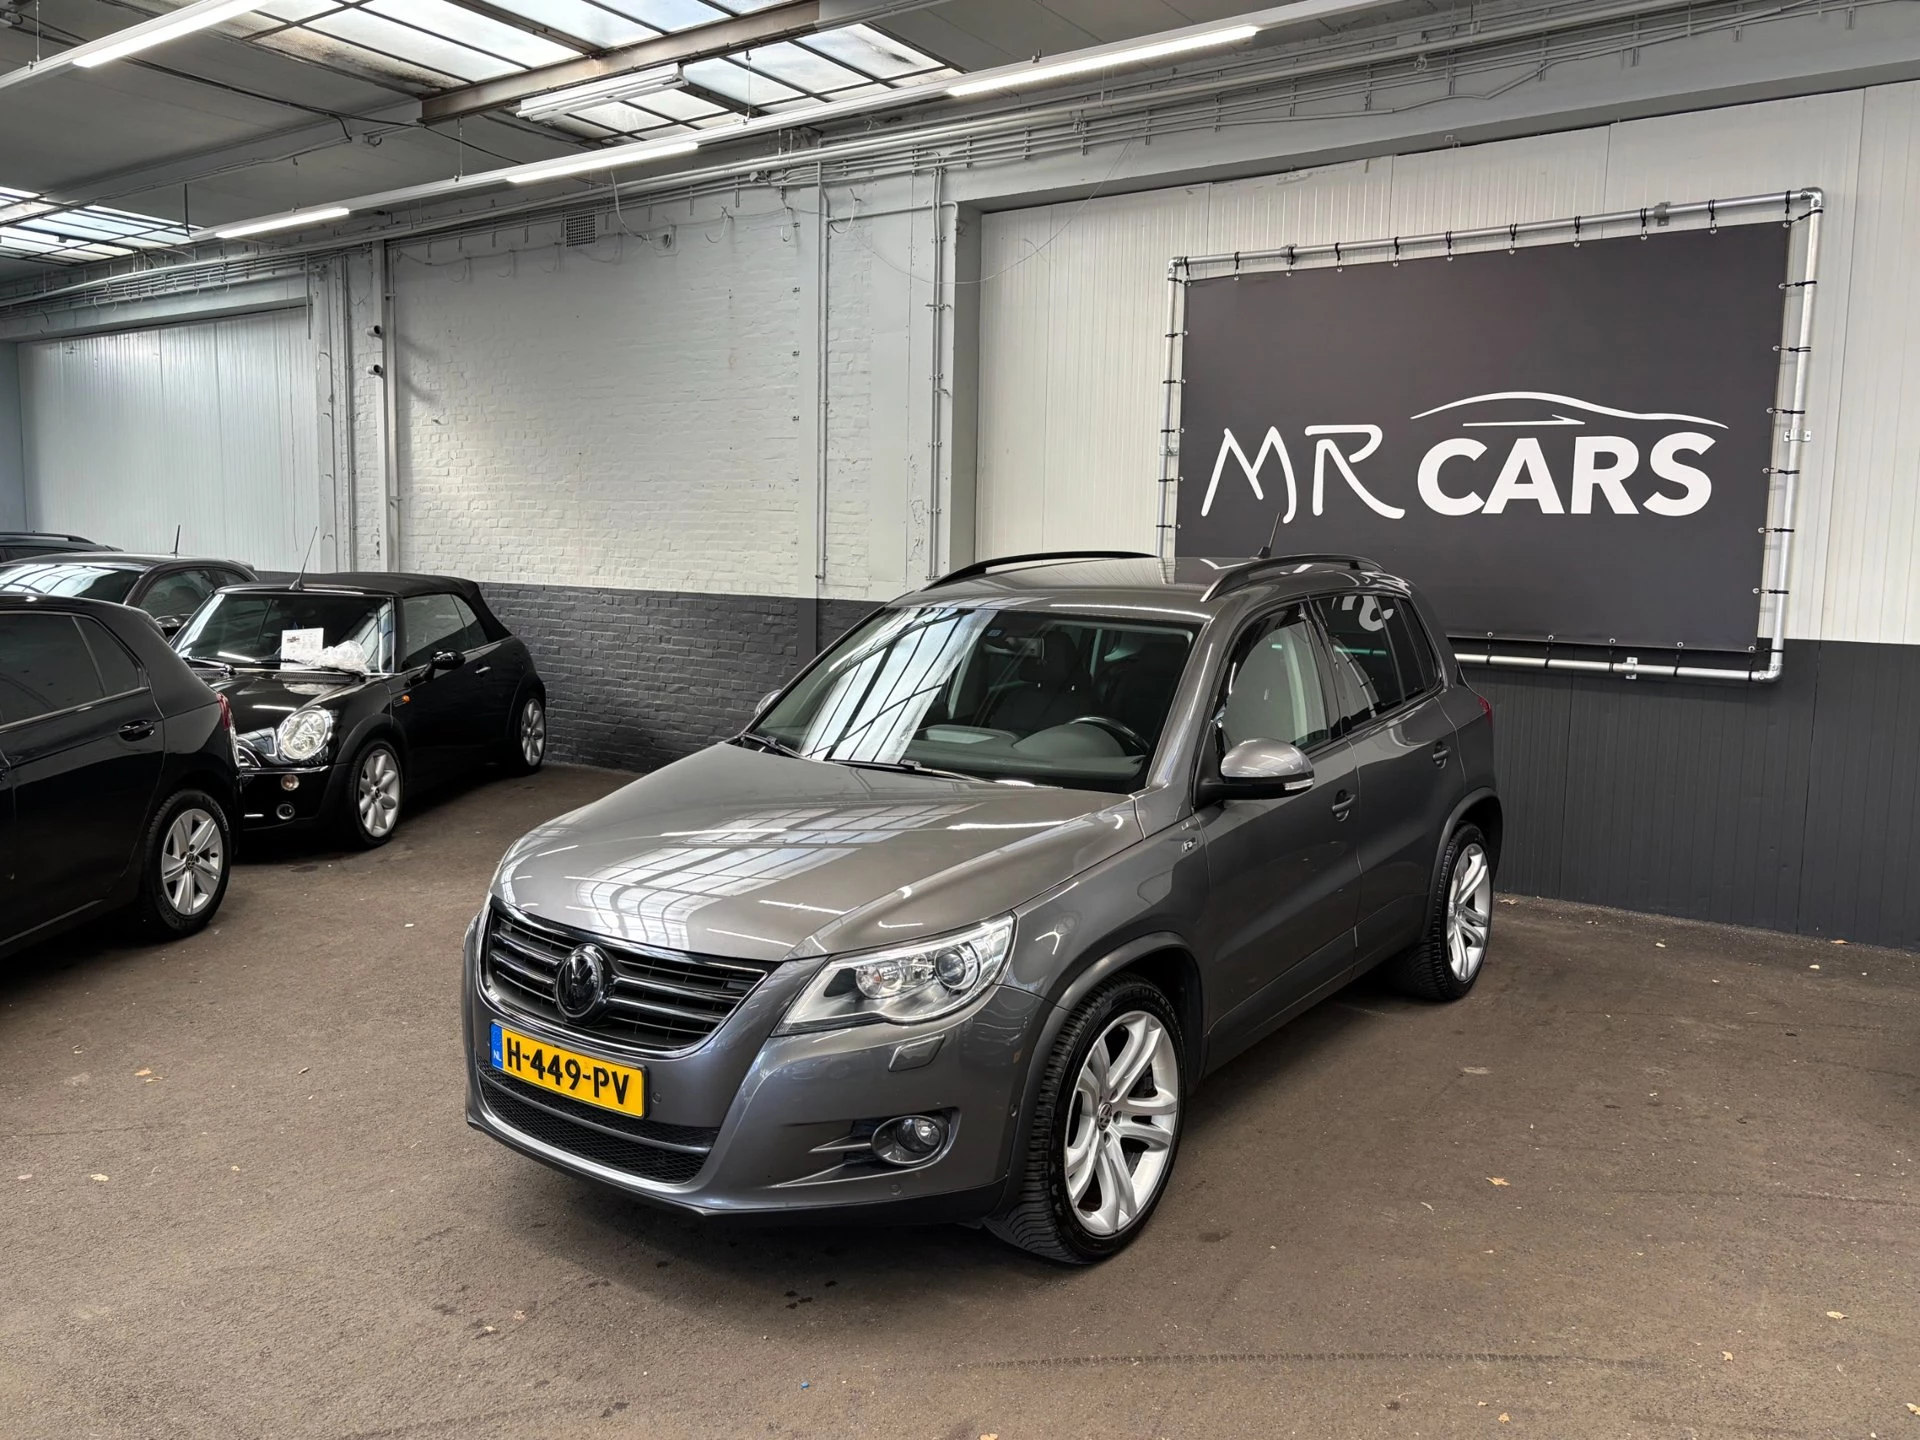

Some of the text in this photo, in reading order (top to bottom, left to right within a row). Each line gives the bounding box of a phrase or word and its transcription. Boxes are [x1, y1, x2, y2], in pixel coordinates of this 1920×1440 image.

[1201, 424, 1716, 523] MR CARS
[493, 1051, 502, 1062] NL
[506, 1037, 630, 1105] H-449-PV
